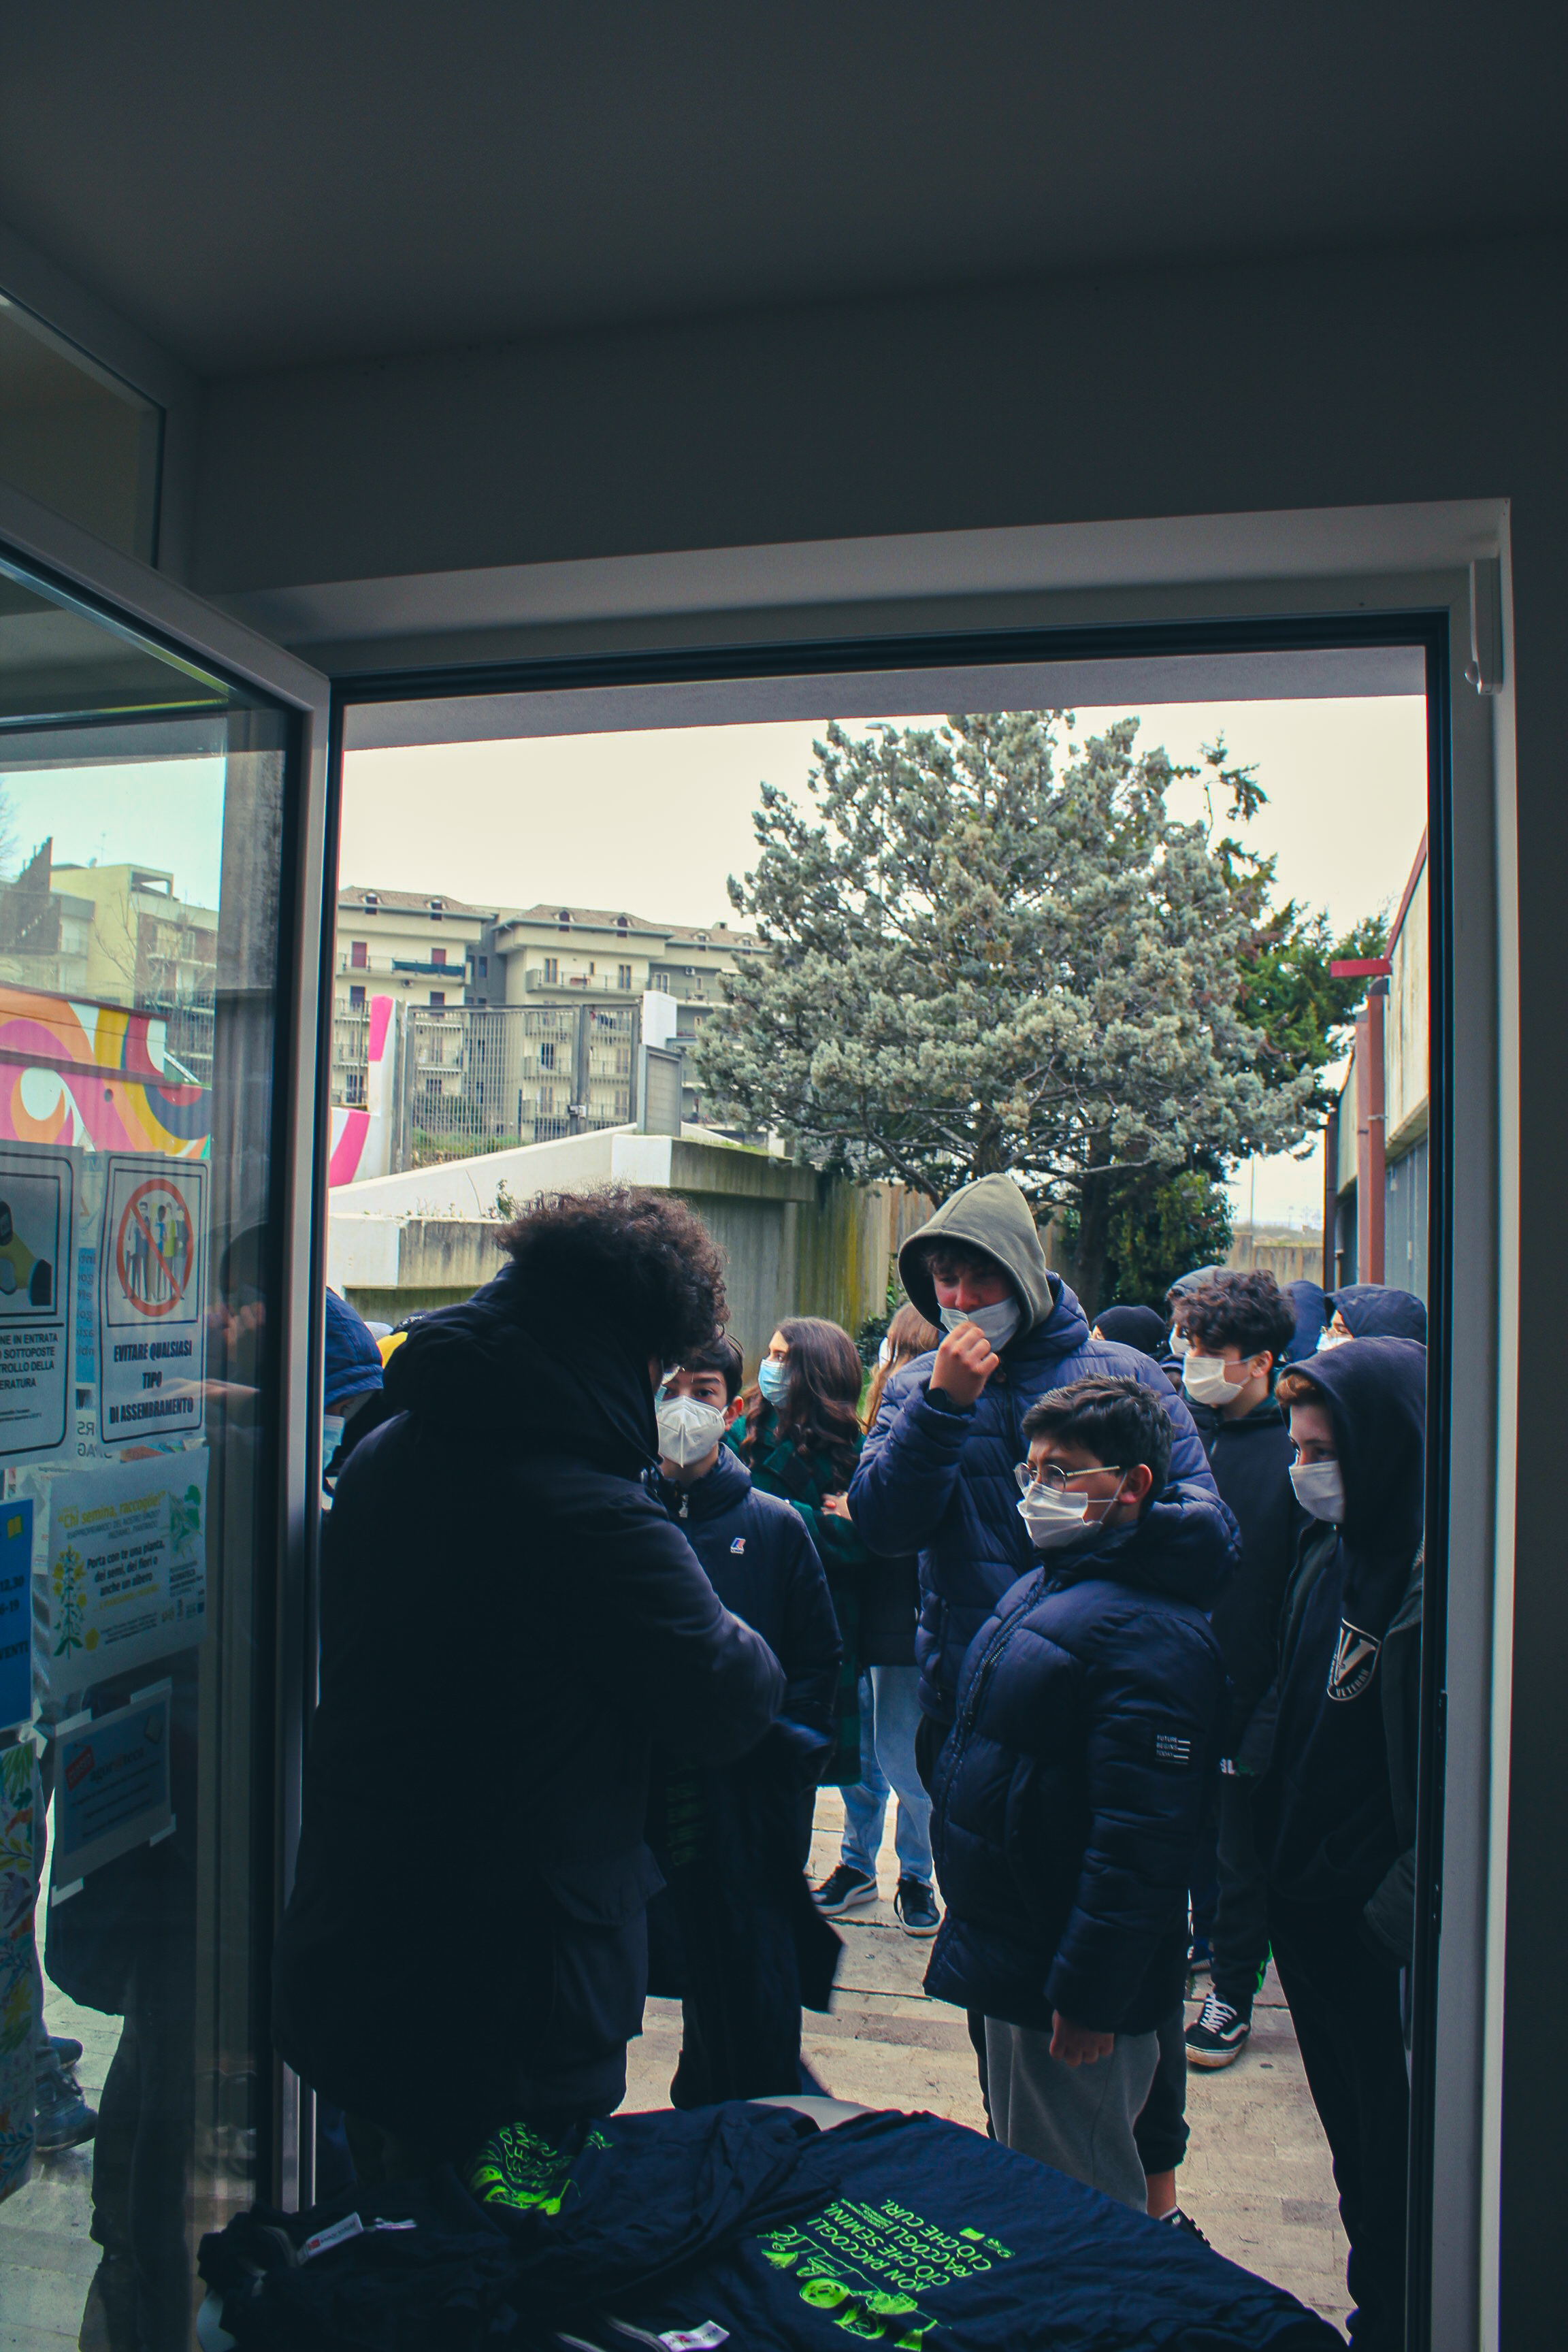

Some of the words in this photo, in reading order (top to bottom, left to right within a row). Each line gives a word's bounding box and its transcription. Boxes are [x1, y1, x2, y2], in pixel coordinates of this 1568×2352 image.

[13, 1335, 22, 1344] IN
[24, 1333, 58, 1344] ENTRATA
[3, 1346, 55, 1359] SOTTOPOSTE
[114, 1343, 148, 1362] EVITARE
[150, 1340, 193, 1360] QUALSIASI
[31, 1360, 54, 1371] DELLA
[142, 1371, 163, 1389] TIPO
[109, 1406, 119, 1424] DI
[120, 1396, 194, 1422] ASSEMBRAMENTO
[87, 1556, 106, 1569] Porta
[107, 1552, 120, 1564] con
[121, 1550, 128, 1560] te
[129, 1546, 142, 1557] una
[95, 1568, 106, 1583] dei
[127, 1558, 137, 1573] dei
[138, 1554, 152, 1569] fiori
[100, 1582, 120, 1597] anche
[122, 1579, 131, 1590] un
[132, 1572, 152, 1586] albero
[1157, 1734, 1177, 1744] FUTURE
[824, 2202, 884, 2247] SEMINI,
[881, 2199, 924, 2227] CURI.
[807, 2218, 890, 2270] RACCOGLI
[919, 2225, 960, 2249] CHE
[877, 2244, 918, 2267] CHE
[885, 2225, 973, 2277] RACCOGLI
[956, 2244, 992, 2270] CIÒ
[884, 2269, 930, 2291] NON
[915, 2265, 950, 2285] CIÒ
